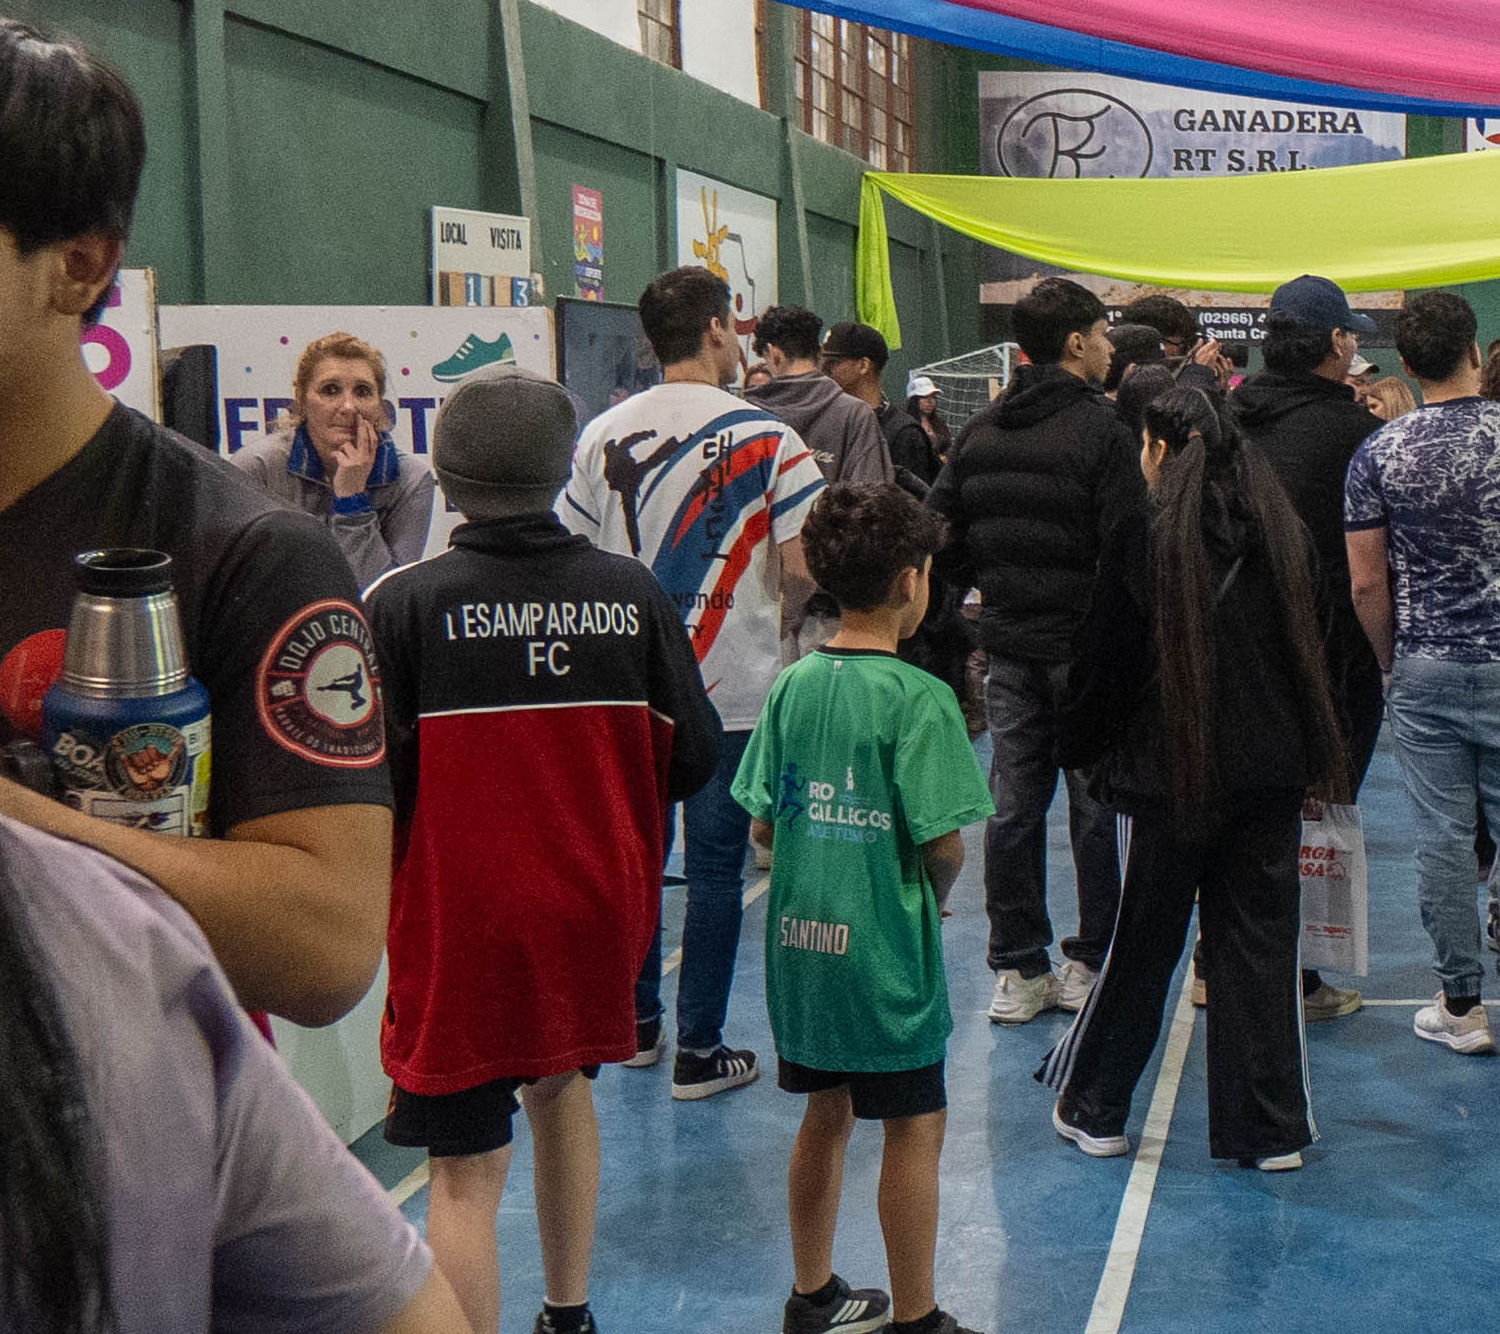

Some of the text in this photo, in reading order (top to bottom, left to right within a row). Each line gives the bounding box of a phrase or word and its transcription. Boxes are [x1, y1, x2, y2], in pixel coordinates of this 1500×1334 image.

[1173, 108, 1363, 135] GANADERA
[1172, 149, 1316, 172] RT S.R.L.
[440, 221, 522, 251] LOCAL VISITA
[467, 275, 529, 306] 1 3
[1199, 312, 1254, 326] (02966)
[1206, 328, 1267, 339] Santa Cr
[279, 620, 327, 670] DOJO
[527, 640, 572, 676] FC
[809, 780, 836, 801] RO
[781, 915, 850, 956] SANTINO
